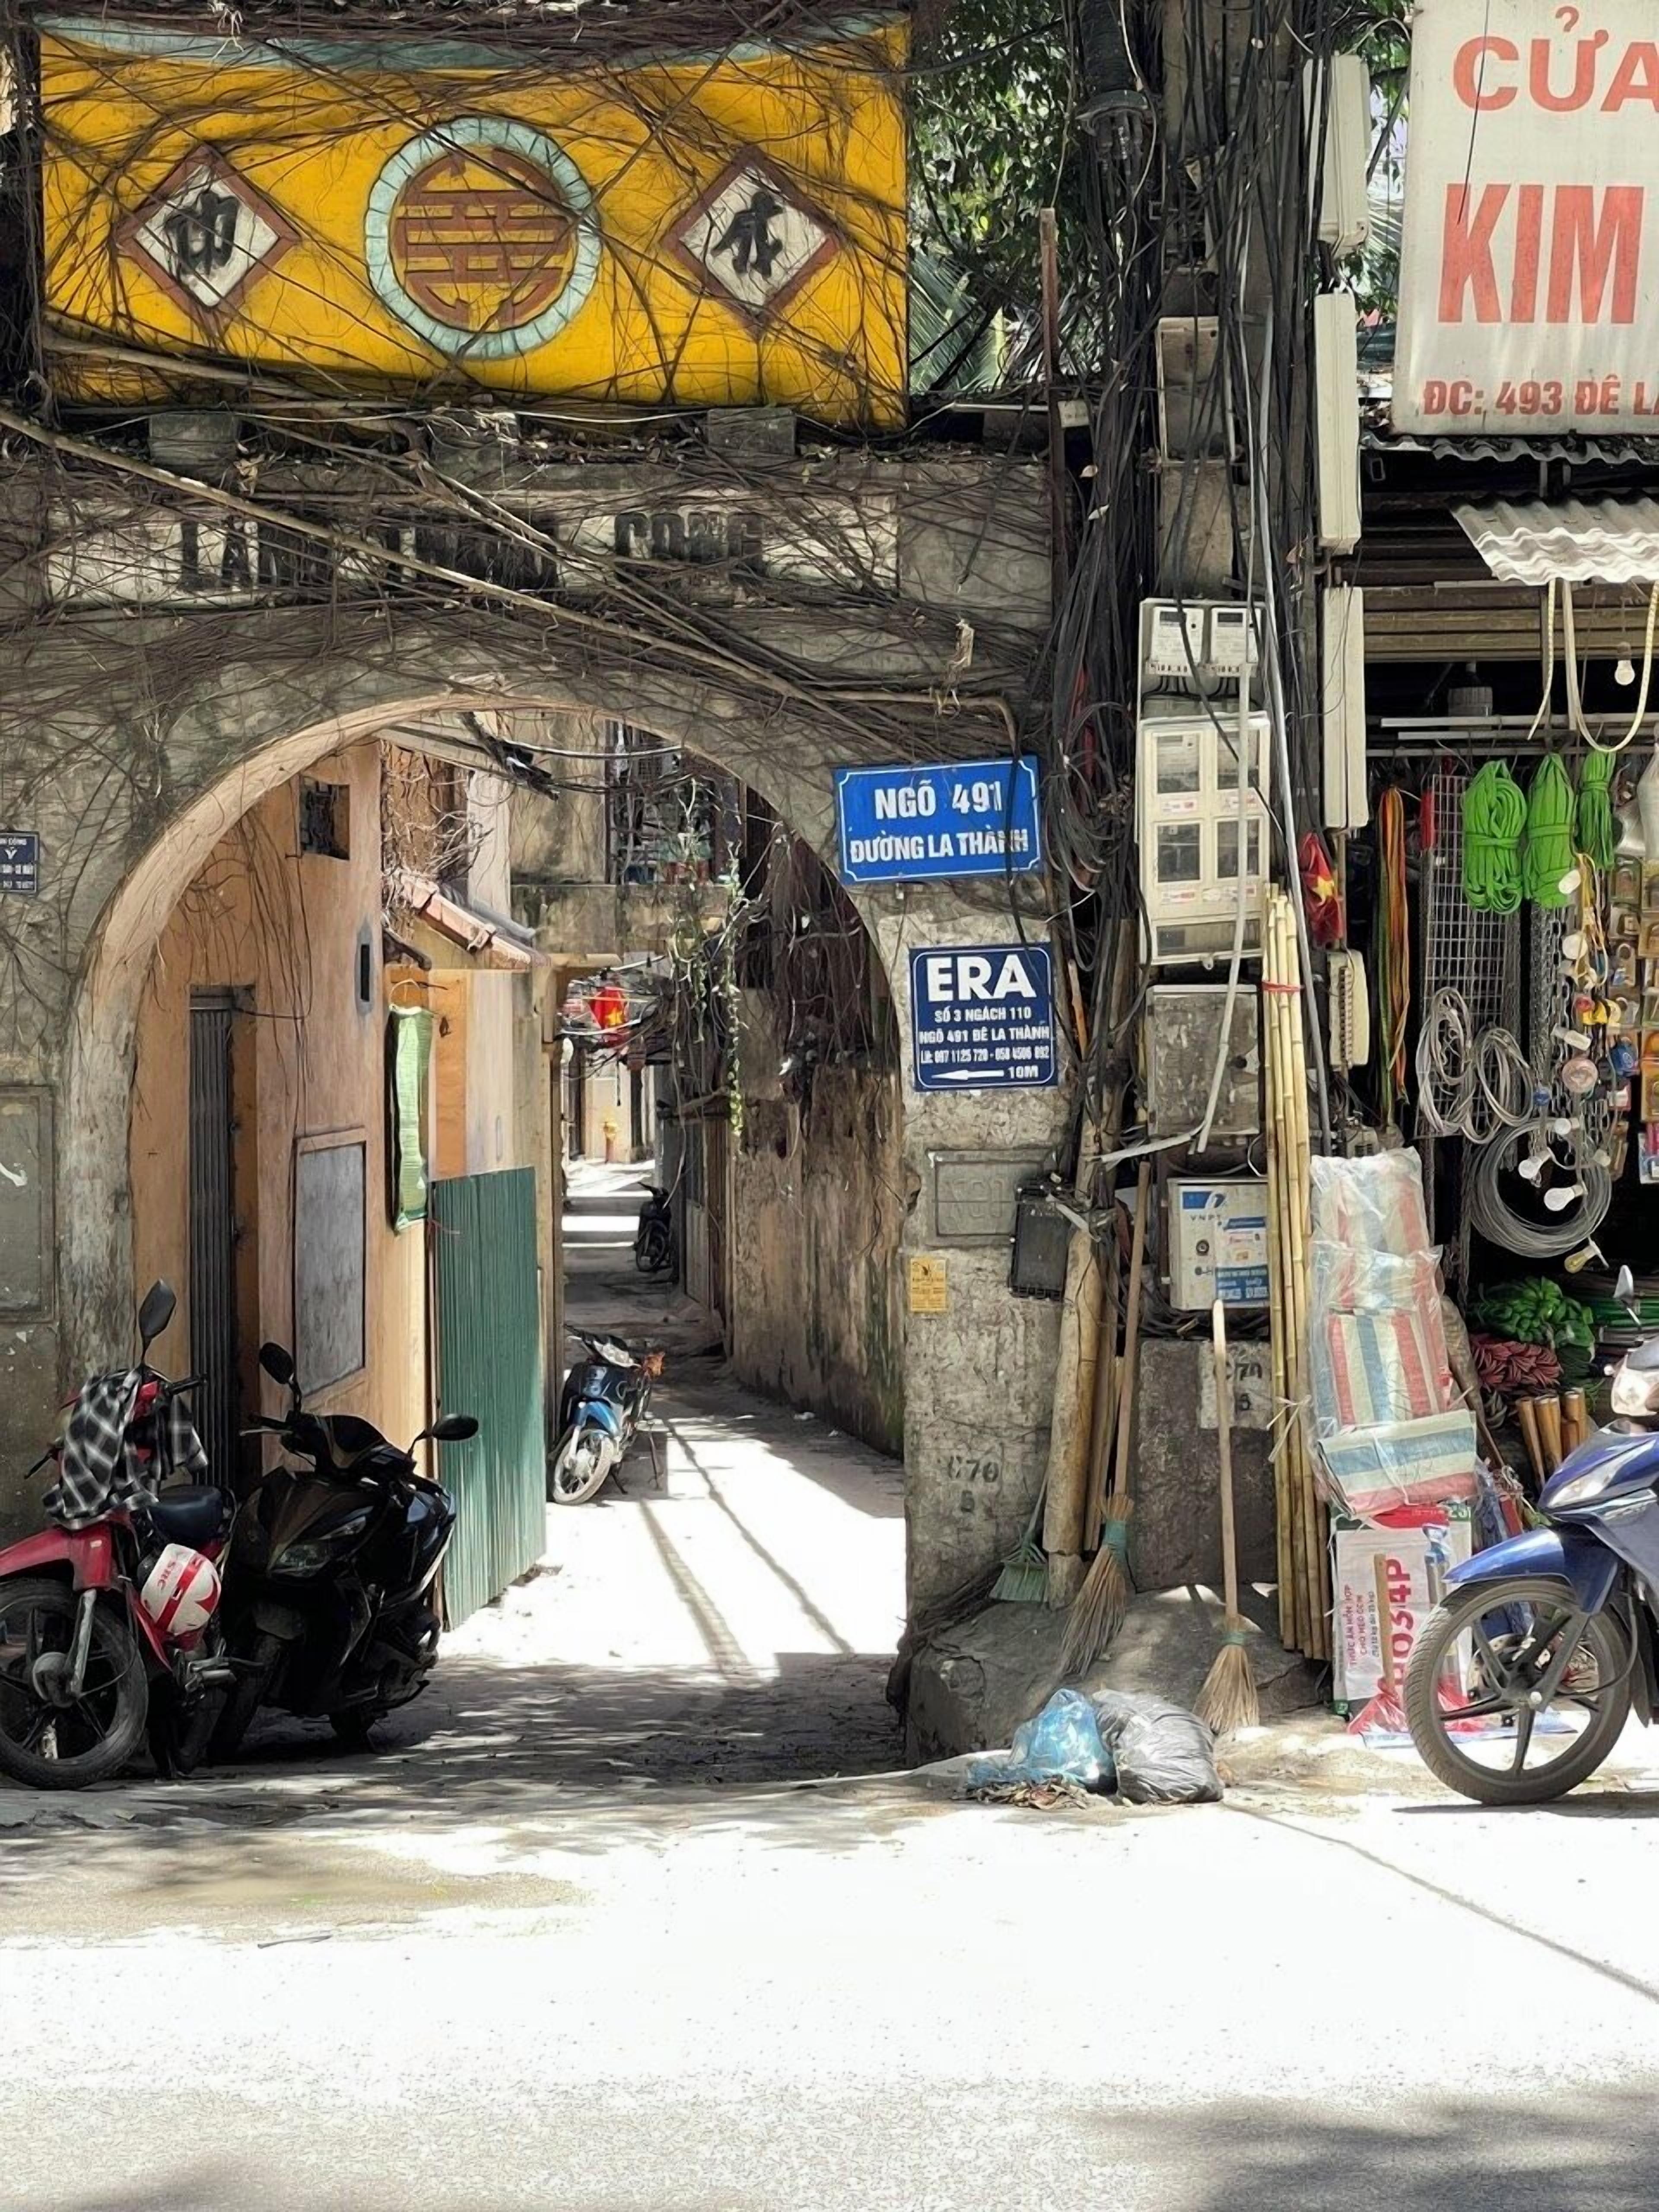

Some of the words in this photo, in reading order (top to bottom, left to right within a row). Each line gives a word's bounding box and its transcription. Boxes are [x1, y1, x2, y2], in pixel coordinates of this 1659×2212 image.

[1453, 6, 1659, 112] CỬA
[1438, 183, 1645, 324] KIM
[1423, 381, 1484, 415] ĐC:
[1495, 381, 1563, 415] 493
[1575, 373, 1621, 415] ĐÊ
[874, 779, 936, 820] NGÕ
[952, 781, 1002, 814] 491
[850, 830, 925, 863] ĐƯỜNG
[928, 833, 954, 858] LA
[927, 954, 1037, 1001] ERA
[934, 1006, 951, 1023] SỐ
[953, 1009, 961, 1022] 3
[965, 1006, 1006, 1021] NGÁCH
[1010, 1007, 1032, 1020] 110
[947, 1030, 969, 1042] 491
[992, 1028, 1006, 1041] LA
[1009, 1024, 1050, 1040] THÀNH
